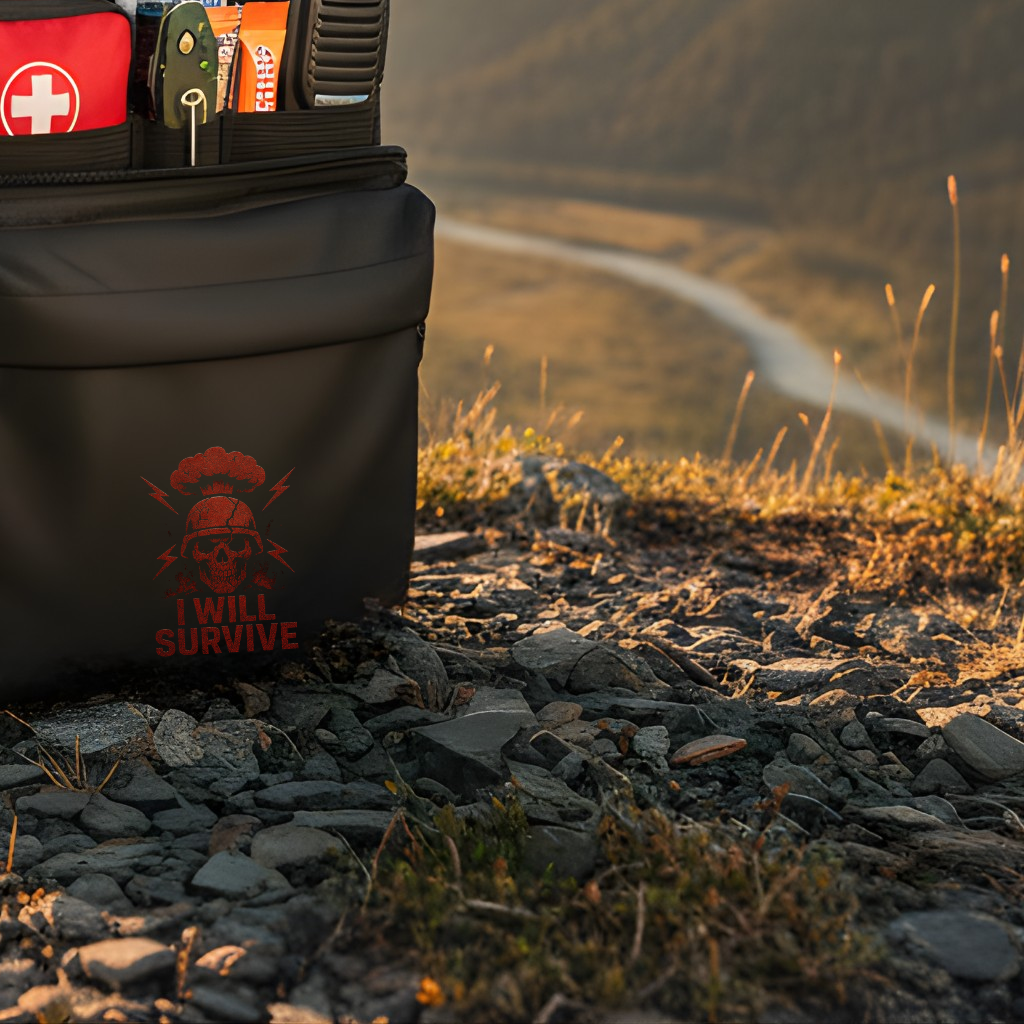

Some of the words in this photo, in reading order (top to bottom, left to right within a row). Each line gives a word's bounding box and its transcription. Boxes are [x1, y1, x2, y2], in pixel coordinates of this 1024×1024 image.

[176, 598, 186, 626] I
[193, 594, 276, 625] WILL
[155, 621, 300, 657] SURVIVE
